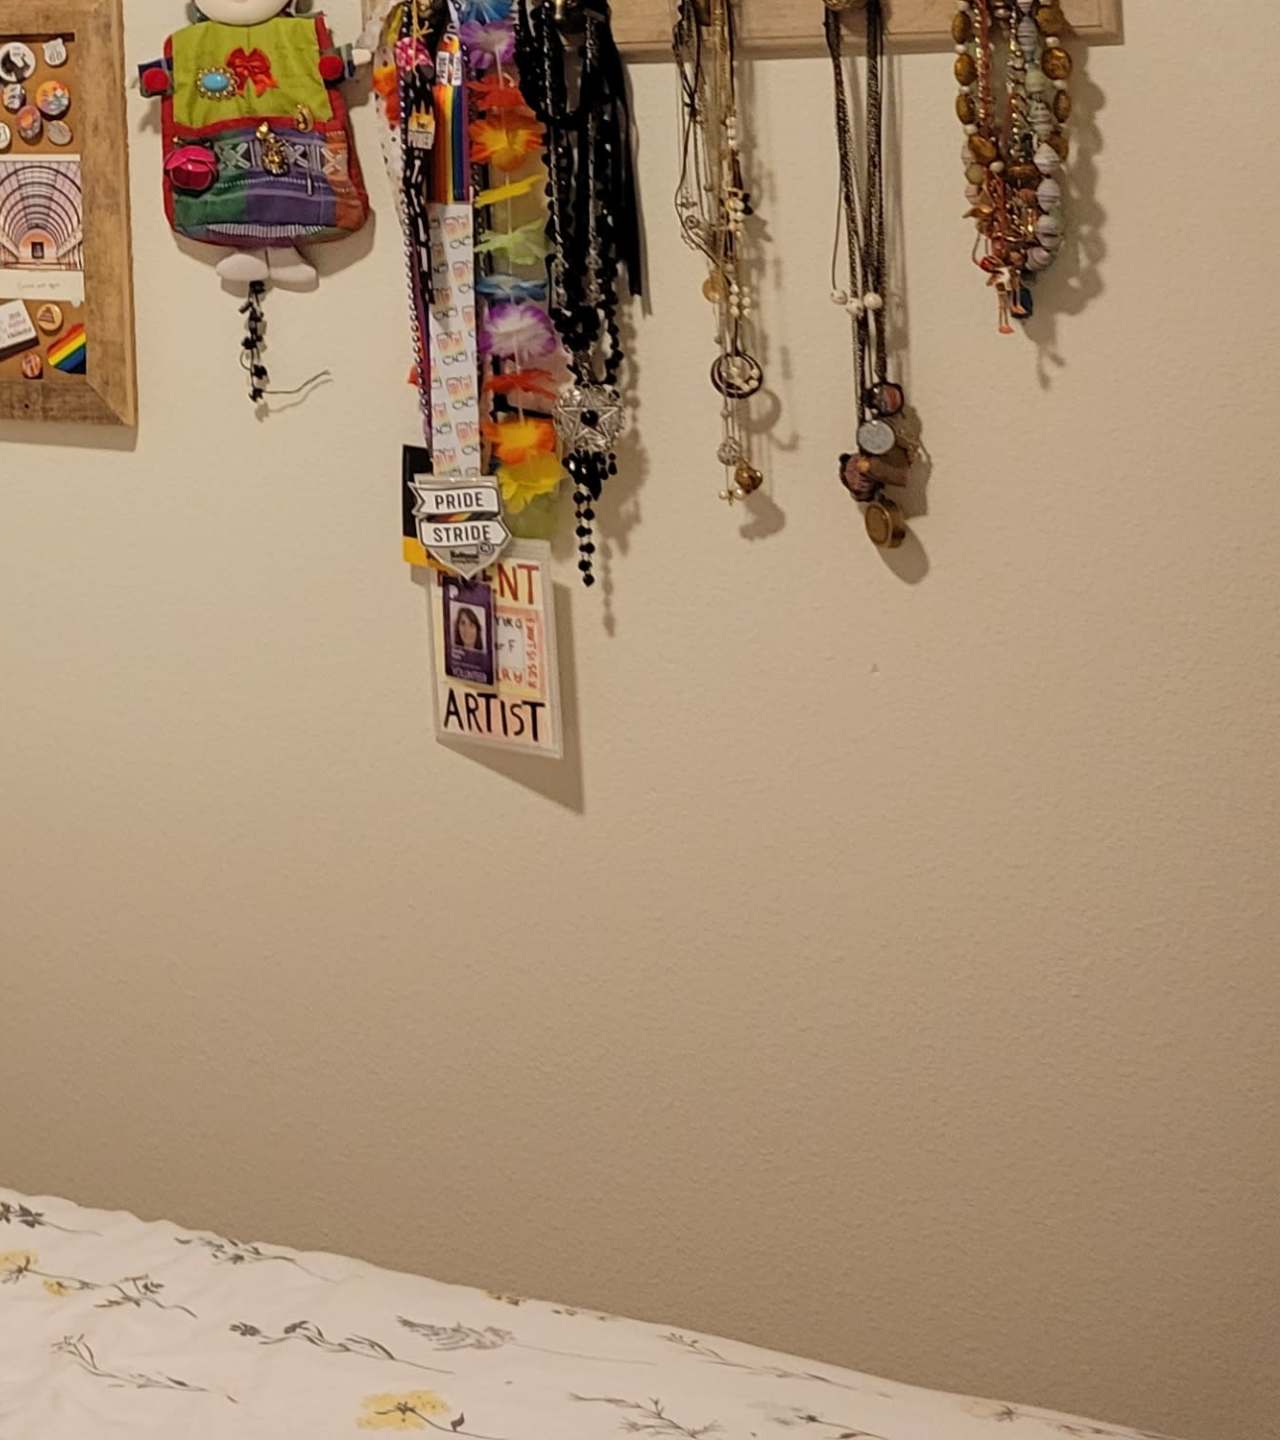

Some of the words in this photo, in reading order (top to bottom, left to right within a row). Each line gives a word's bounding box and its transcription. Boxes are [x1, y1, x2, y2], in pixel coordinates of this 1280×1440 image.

[434, 491, 484, 510] PRIDE
[433, 524, 492, 543] STRIDE
[443, 688, 545, 742] ARTIST
